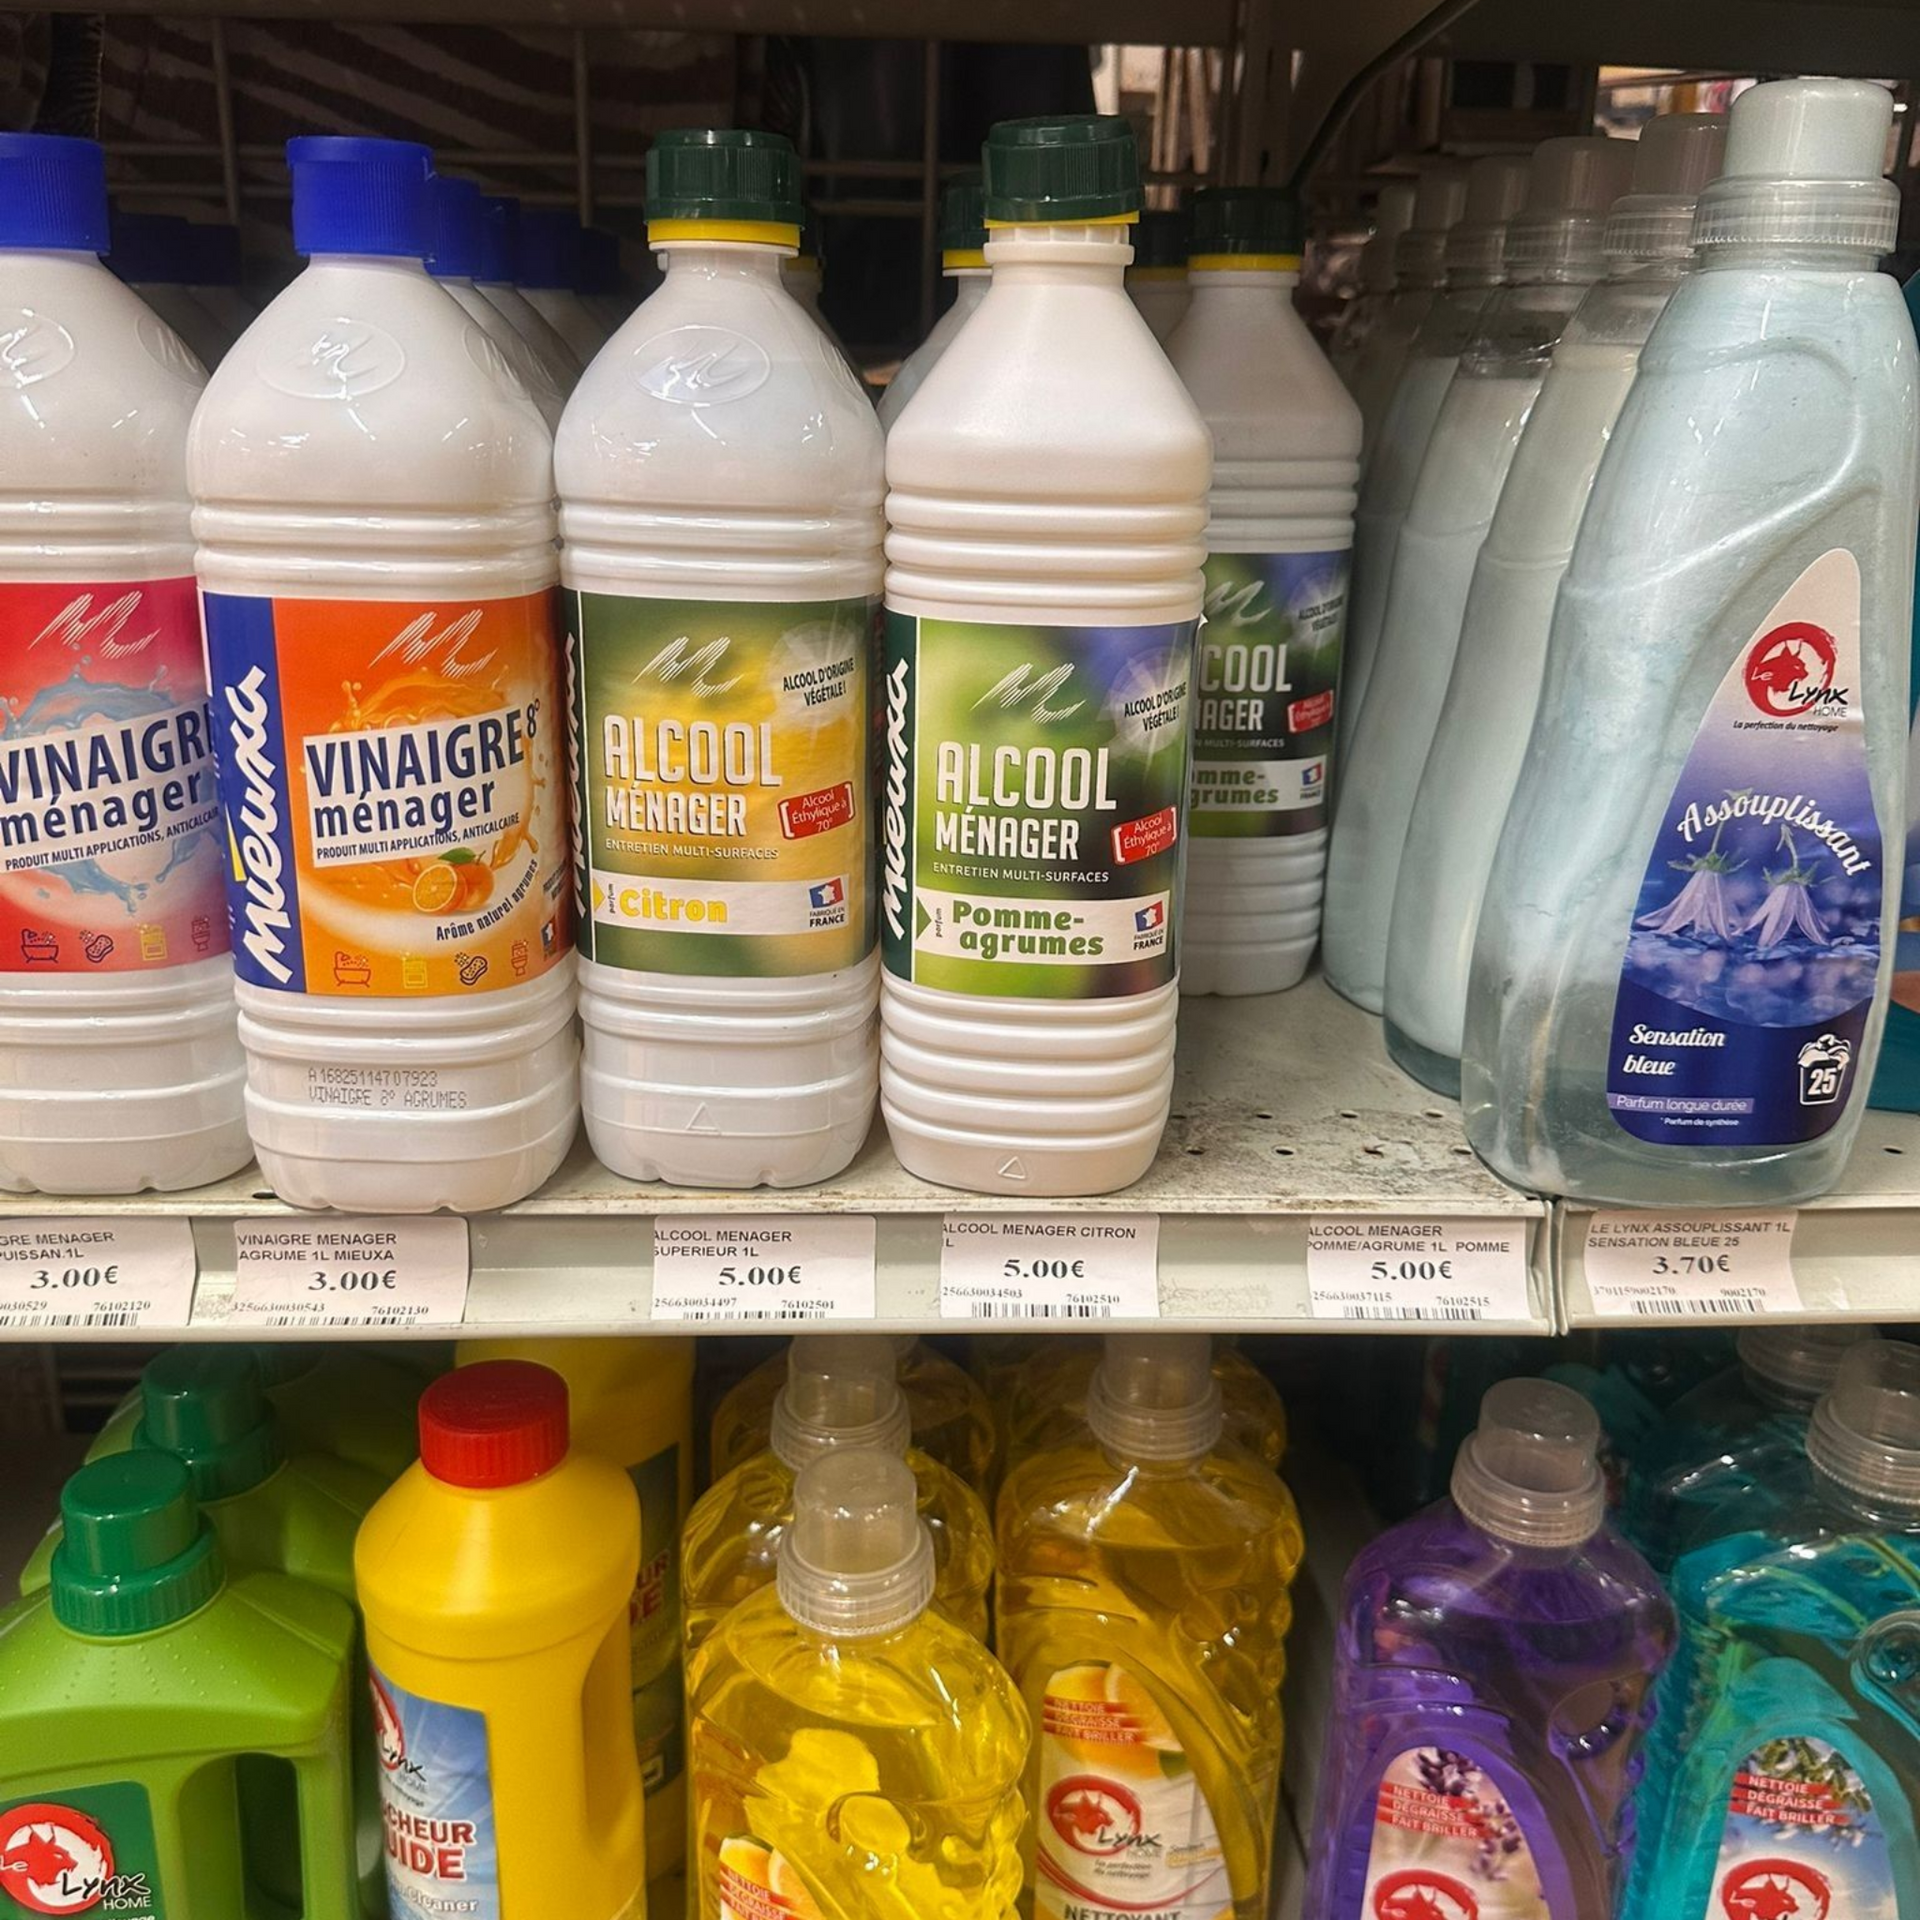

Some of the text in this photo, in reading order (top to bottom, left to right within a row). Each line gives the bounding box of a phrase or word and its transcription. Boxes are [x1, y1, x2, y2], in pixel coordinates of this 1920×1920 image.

[1200, 643, 1293, 692] COOL
[783, 670, 818, 692] ALCOOL
[1788, 681, 1850, 706] Lynx
[1124, 697, 1156, 718] ALCOOL
[1195, 699, 1264, 731] AGER
[1813, 706, 1849, 718] HOME
[1733, 721, 1839, 733] La perfection du nettoyage
[306, 708, 525, 797] VINAIGRE
[603, 715, 784, 787] ALCOOL
[937, 741, 1117, 810] ALCOOL
[0, 771, 201, 847] ménager
[314, 780, 496, 839] ménager
[604, 780, 748, 837] MÉNAGER
[802, 789, 835, 808] Alcool
[1190, 788, 1279, 810] grumes
[792, 803, 840, 825] Éthylique
[1134, 813, 1163, 834] Alcool
[317, 812, 520, 860] PRODUIT MULTI APPLICATIONS, ANTICALCAIRE
[935, 805, 1079, 860] MÉNAGER
[1124, 826, 1167, 850] Éthylique
[1677, 794, 1872, 877] Assouplissant
[6, 853, 50, 871] PRODUIT
[52, 847, 85, 862] MULTI
[86, 829, 165, 855] APPLICATIONS,
[605, 838, 780, 860] ENTRETIEN MULTI-SURFACES
[933, 862, 1109, 883] ENTRETIEN MULTI-SURFACES
[436, 922, 476, 941] Arôme
[476, 898, 514, 930] naturel
[511, 859, 538, 903] agrumes
[607, 883, 616, 914] parfum
[619, 888, 729, 923] Citron
[809, 914, 845, 928] FRANCE
[935, 908, 943, 938] parfum
[953, 900, 1084, 931] Pomme-
[959, 931, 1104, 959] agrumes
[1133, 937, 1163, 951] FRANCE
[1629, 1023, 1726, 1047] Sensation
[1622, 1054, 1676, 1076] bleue
[1807, 1067, 1837, 1096] 25
[309, 1086, 371, 1106] VINAIGRE
[403, 1091, 468, 1109] AGRUMES
[1616, 1095, 1748, 1113] Parfum longue durée
[1694, 1118, 1704, 1126] de
[0, 1231, 116, 1246] GRE MENAGER
[654, 1230, 792, 1242] ALCOOL MENAGER
[942, 1222, 1136, 1239] ALCOOL MENAGER CITRON
[1368, 1225, 1443, 1237] MENAGER
[1590, 1222, 1791, 1234] LE LYNX ASSOUPLISSANT 1L
[237, 1233, 397, 1246] VINAIGRE MENAGER
[1307, 1240, 1511, 1253] POMME/AGRUME 1L POMME
[1588, 1236, 1740, 1248] SENSATION BLEUE 25
[239, 1250, 395, 1261] AGRUME 1L MIEUXA
[653, 1246, 759, 1257] SUPERIEUR 1L
[718, 1265, 802, 1286] 5.00€
[1003, 1259, 1085, 1279] 5.00€
[1371, 1260, 1453, 1280] 5.00€
[1652, 1254, 1731, 1275] 3.70€
[30, 1265, 118, 1289] 3.00€
[308, 1269, 397, 1291] 3.00€
[93, 1301, 151, 1311] 76102120
[781, 1299, 835, 1310] 76102501
[1066, 1293, 1120, 1304] 76102510
[1436, 1296, 1491, 1306] 76102515
[371, 1306, 429, 1315] 76102130
[1749, 1775, 1808, 1794] NETTOIE
[1393, 1785, 1450, 1807] NETTOIE
[1747, 1789, 1824, 1810] DÉGRAISSE
[1392, 1800, 1464, 1821] DÉGRAISSE
[1746, 1803, 1835, 1824] FAIT BRILLER
[1098, 1826, 1163, 1848] Lynx
[1391, 1814, 1478, 1838] FAIT BRILLER
[386, 1829, 465, 1880] UIDE
[62, 1872, 152, 1900] Lynx
[103, 1896, 152, 1911] HOME
